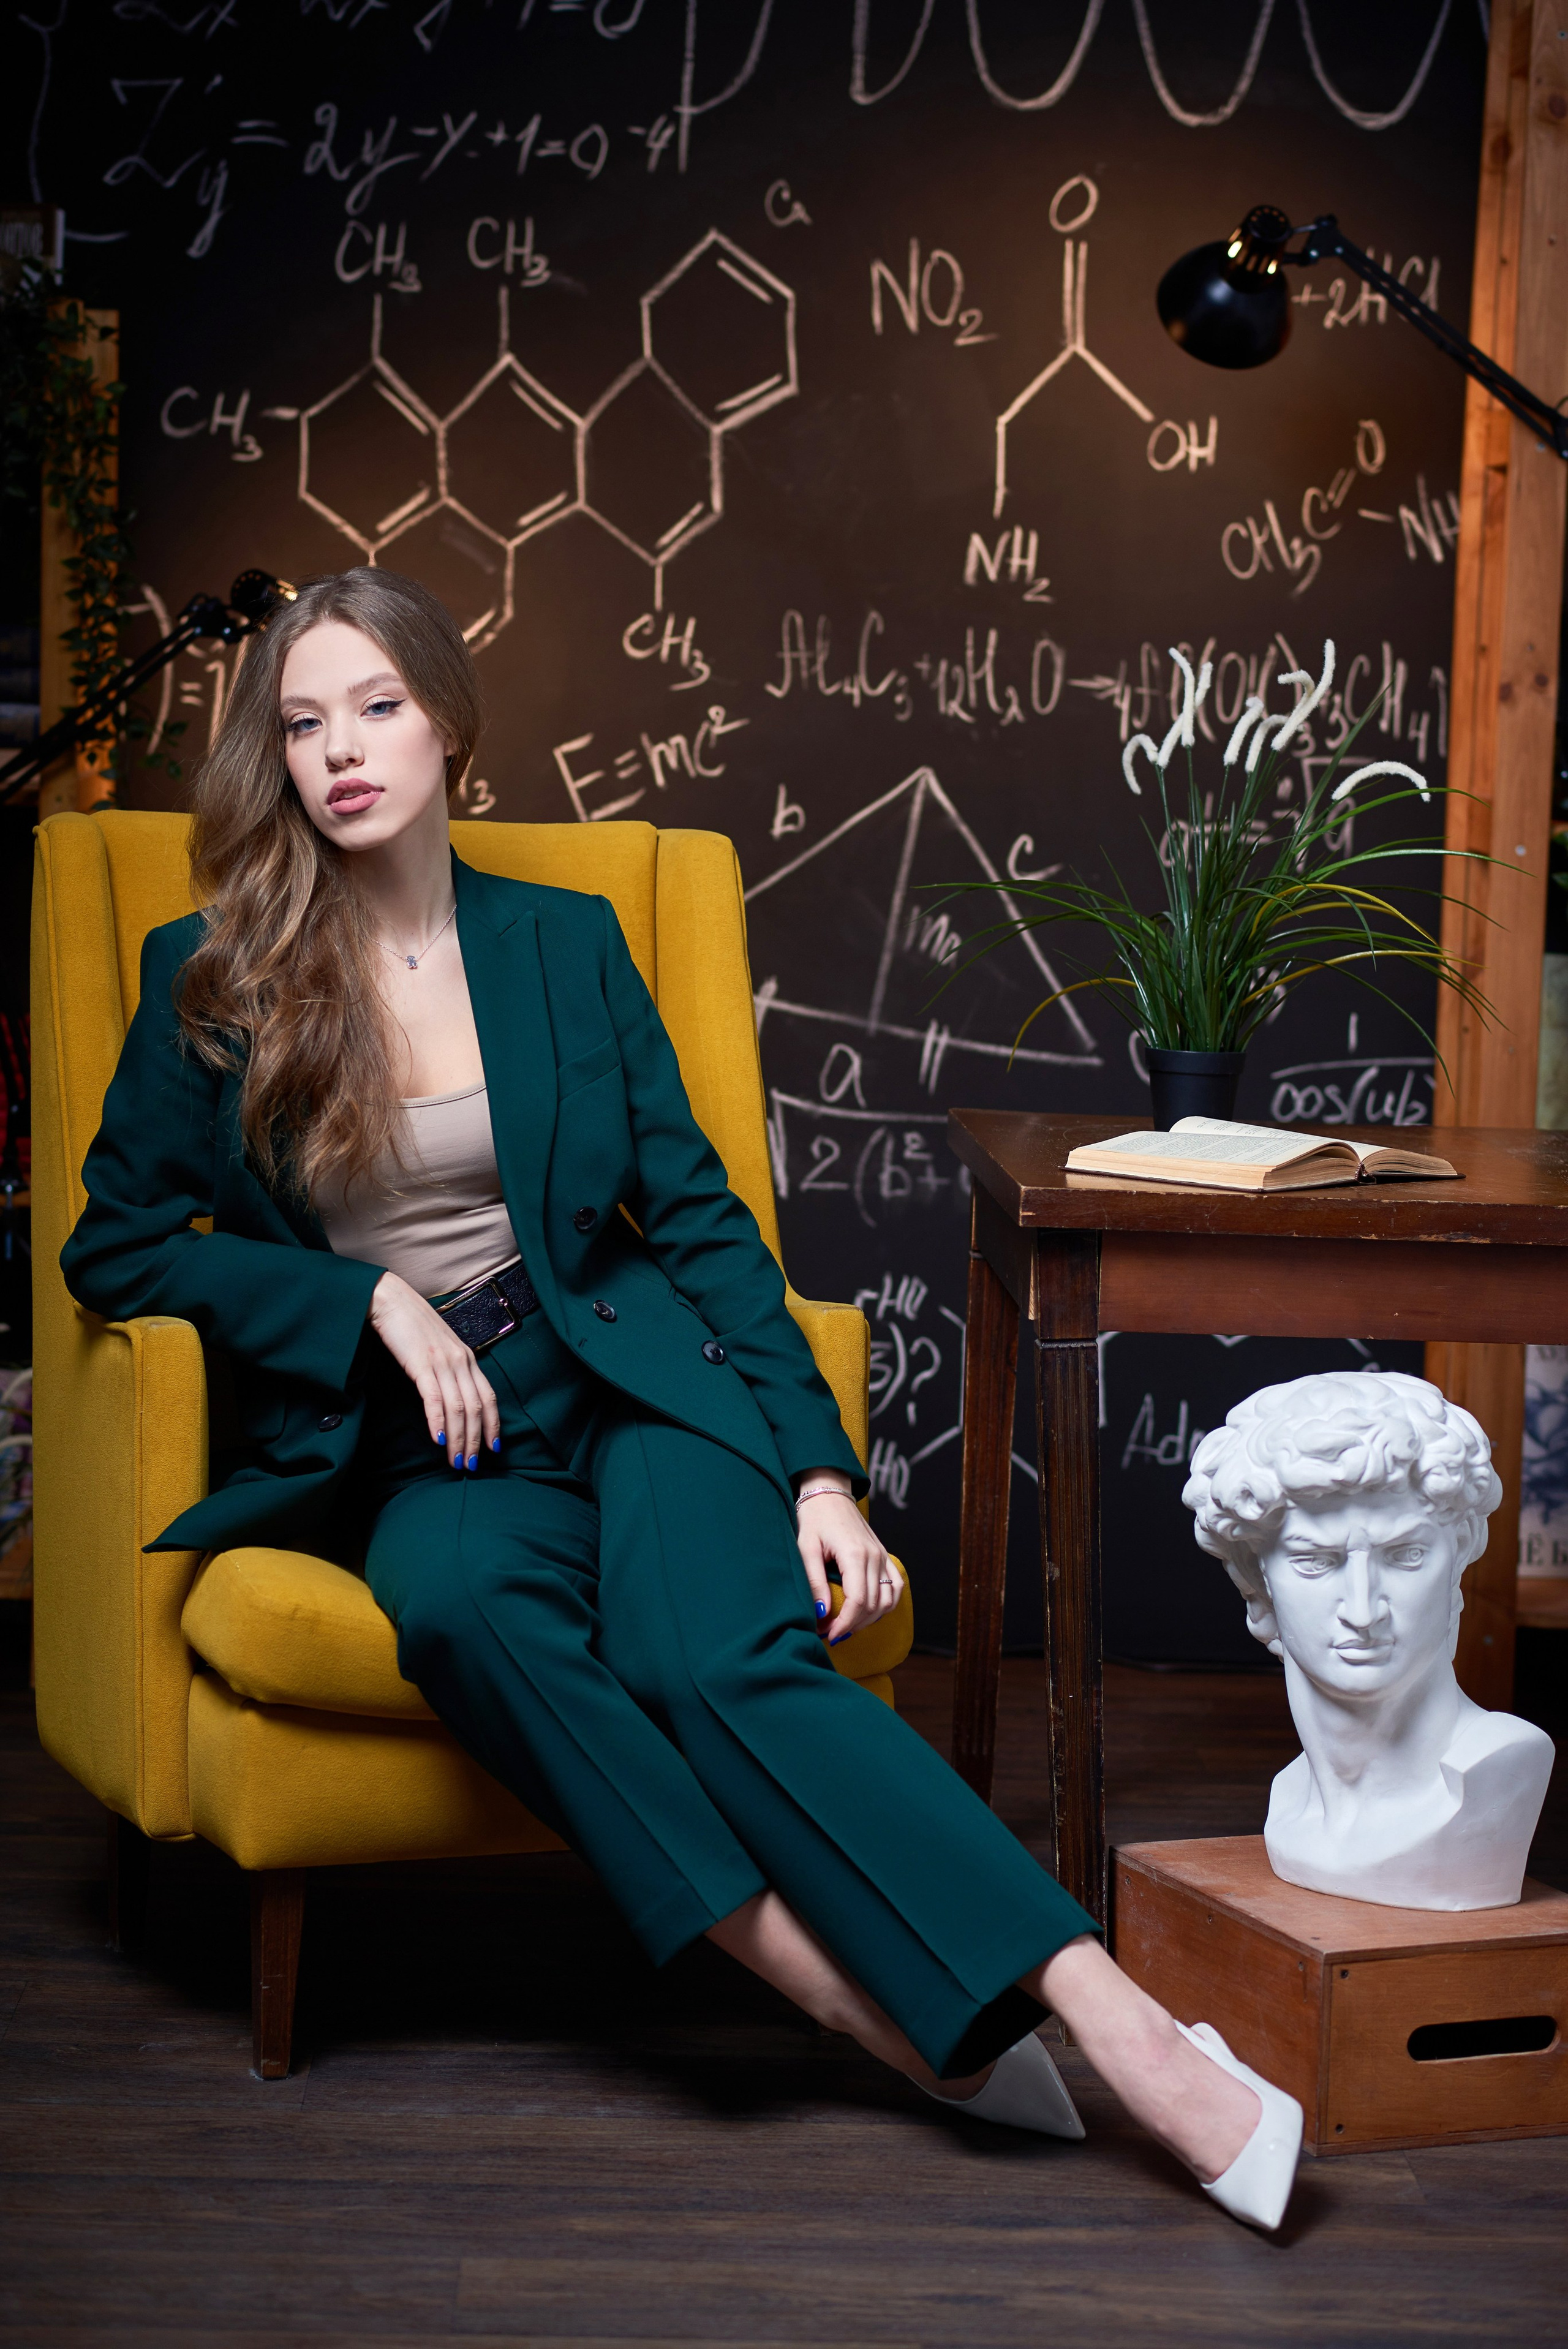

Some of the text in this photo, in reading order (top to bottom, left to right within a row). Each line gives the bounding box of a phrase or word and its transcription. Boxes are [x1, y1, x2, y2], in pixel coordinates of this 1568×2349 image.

[870, 237, 999, 347] NO2
[160, 385, 264, 462] CH3
[1147, 415, 1218, 473] OH
[963, 524, 1056, 604] NH2
[622, 613, 710, 691] CH3
